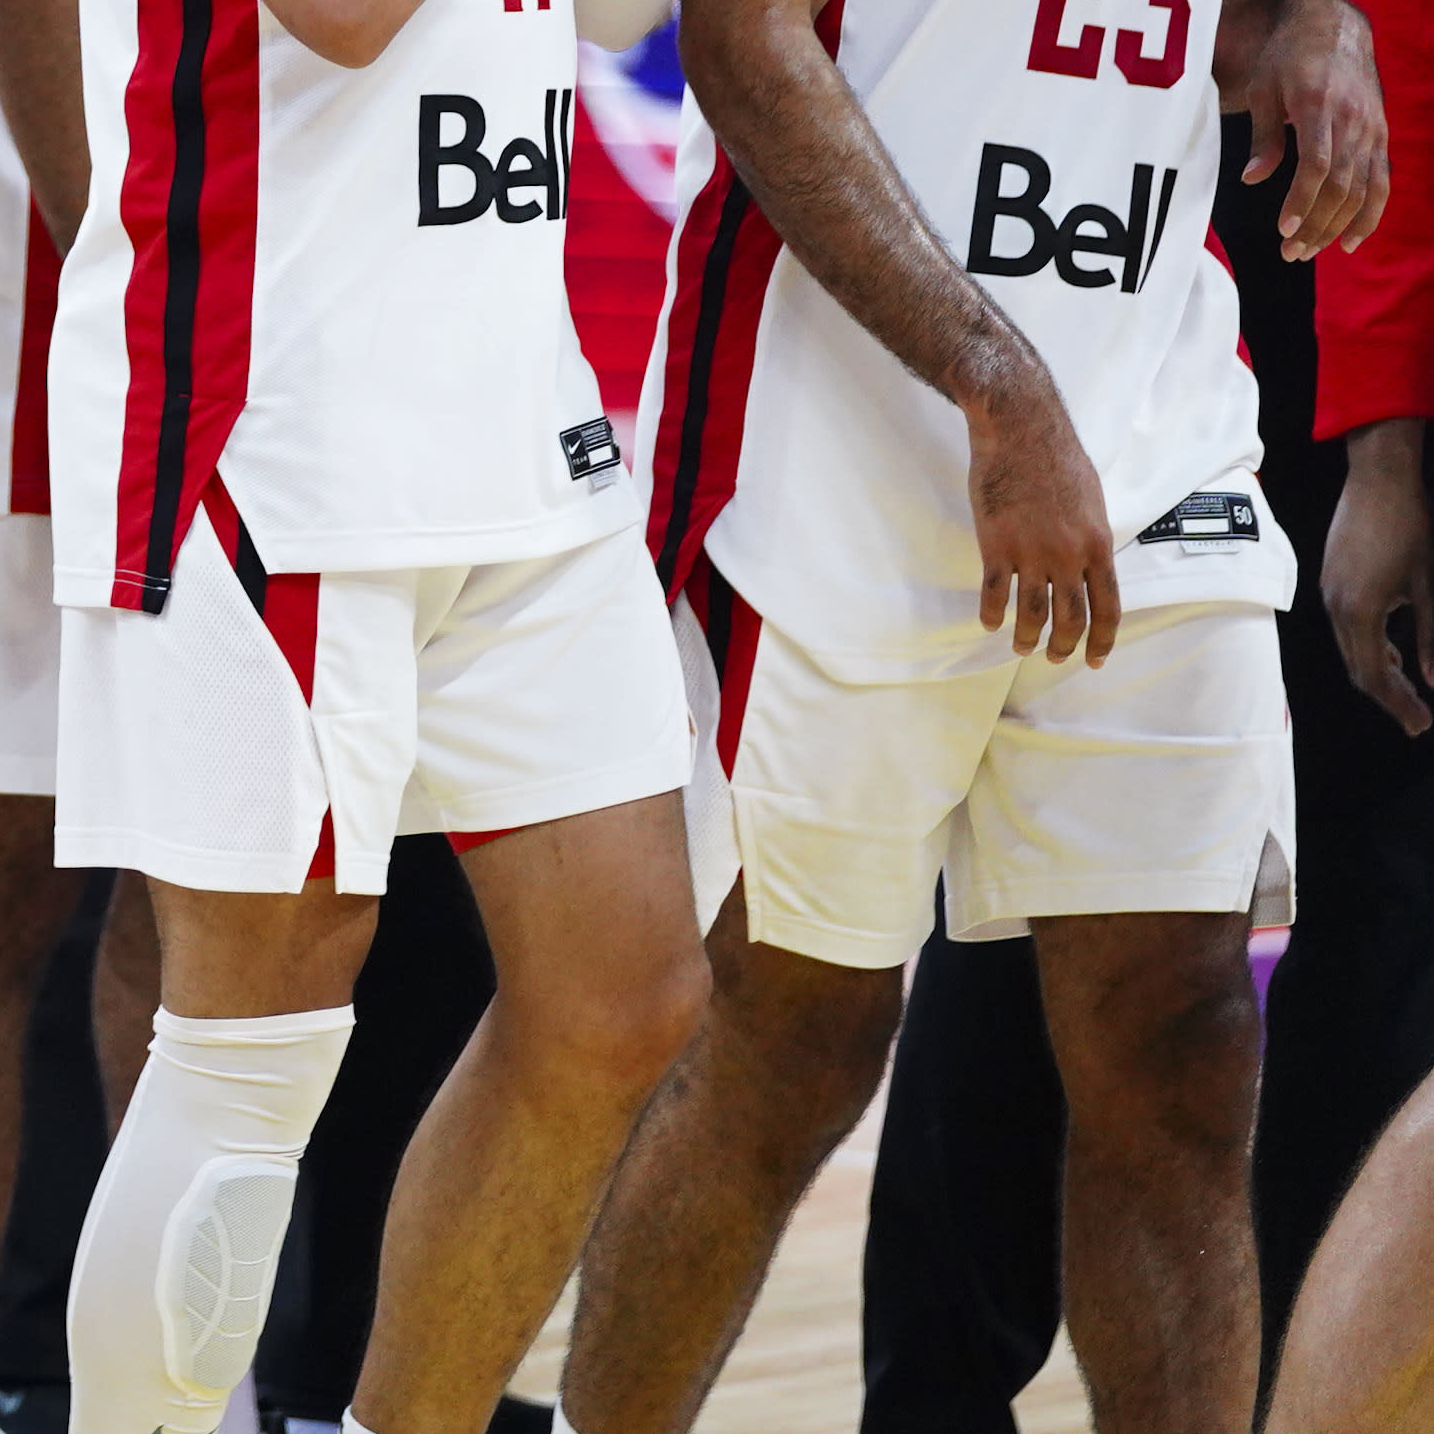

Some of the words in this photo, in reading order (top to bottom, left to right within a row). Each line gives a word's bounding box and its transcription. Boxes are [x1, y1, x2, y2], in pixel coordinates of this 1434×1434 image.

[418, 89, 573, 226] Bell
[966, 143, 1178, 295] Bell
[1233, 505, 1253, 526] 50
